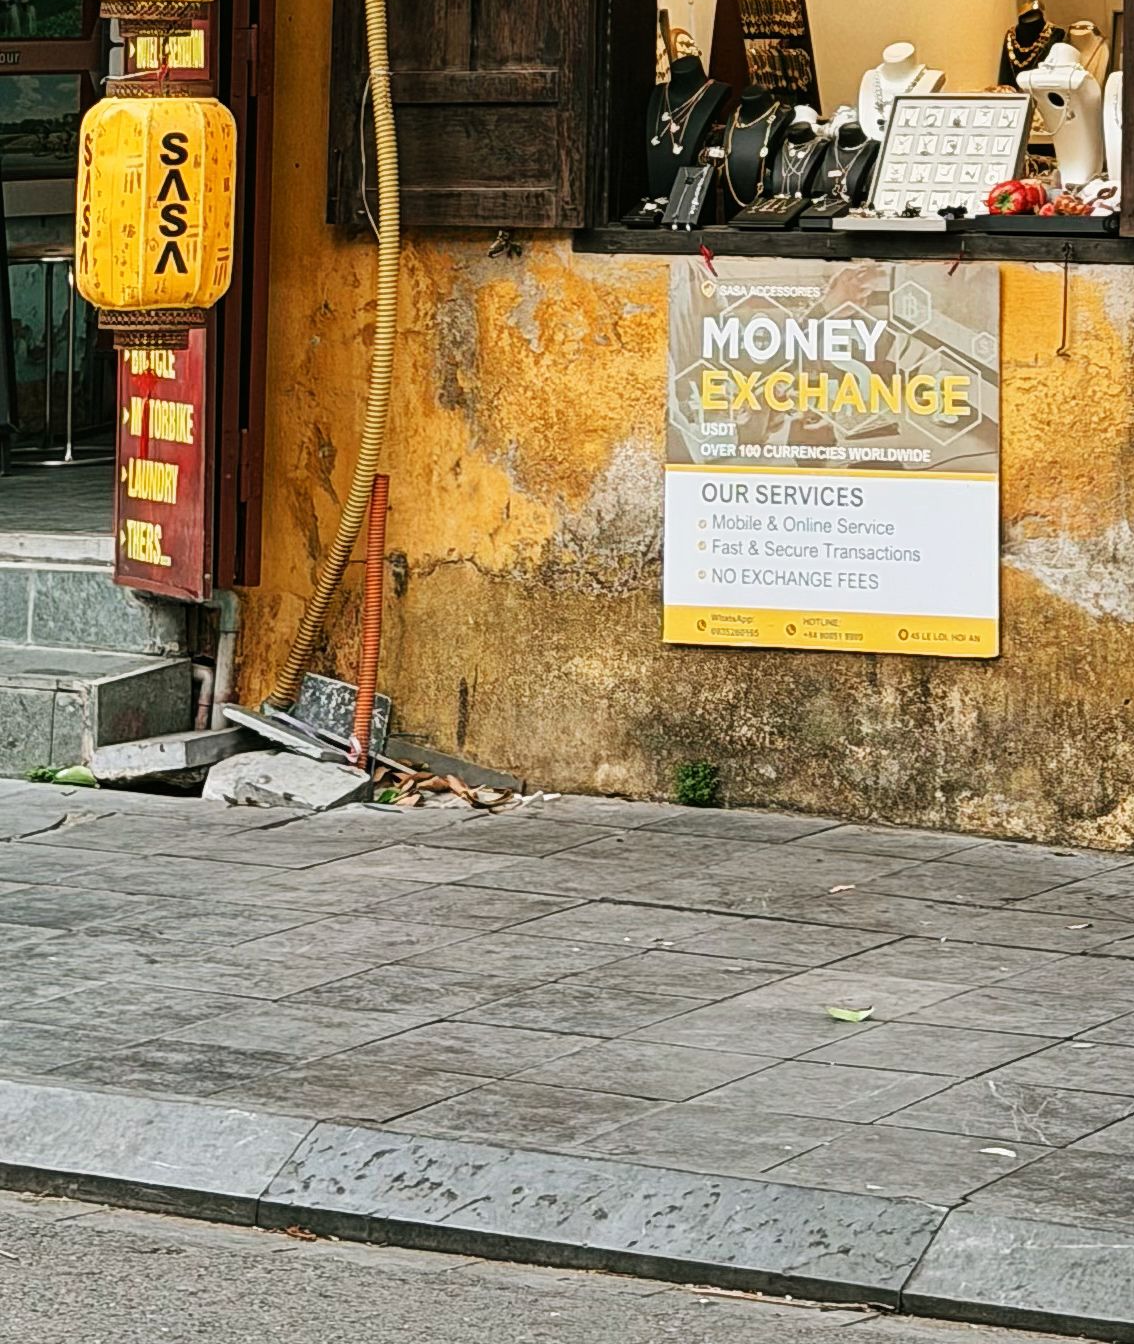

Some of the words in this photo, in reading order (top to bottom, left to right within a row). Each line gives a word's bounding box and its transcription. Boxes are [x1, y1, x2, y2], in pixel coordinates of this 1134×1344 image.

[79, 132, 93, 275] SASA
[153, 132, 190, 275] SASA
[719, 284, 748, 297] SASA
[702, 316, 888, 362] MONEY
[702, 370, 971, 416] EXCHANGE
[130, 396, 194, 444] MTORBIKE
[701, 423, 737, 436] USDT
[701, 444, 736, 457] OVER
[738, 444, 761, 457] 100
[763, 446, 846, 460] CURRENCIES
[848, 448, 931, 462] WORLDWIDE
[128, 457, 179, 504] LAUNDRY
[701, 483, 749, 504] OUR
[755, 484, 864, 507] SERVICES
[712, 514, 762, 531] Mobile
[766, 516, 778, 531] &
[783, 515, 832, 533] Online
[837, 517, 895, 535] Service
[712, 539, 743, 555] Fast
[748, 540, 759, 555] &
[764, 541, 818, 558] Secure
[823, 543, 921, 562] Transactions
[712, 568, 737, 584] NO
[741, 568, 832, 587] EXCHANGE
[838, 573, 879, 589] FEES
